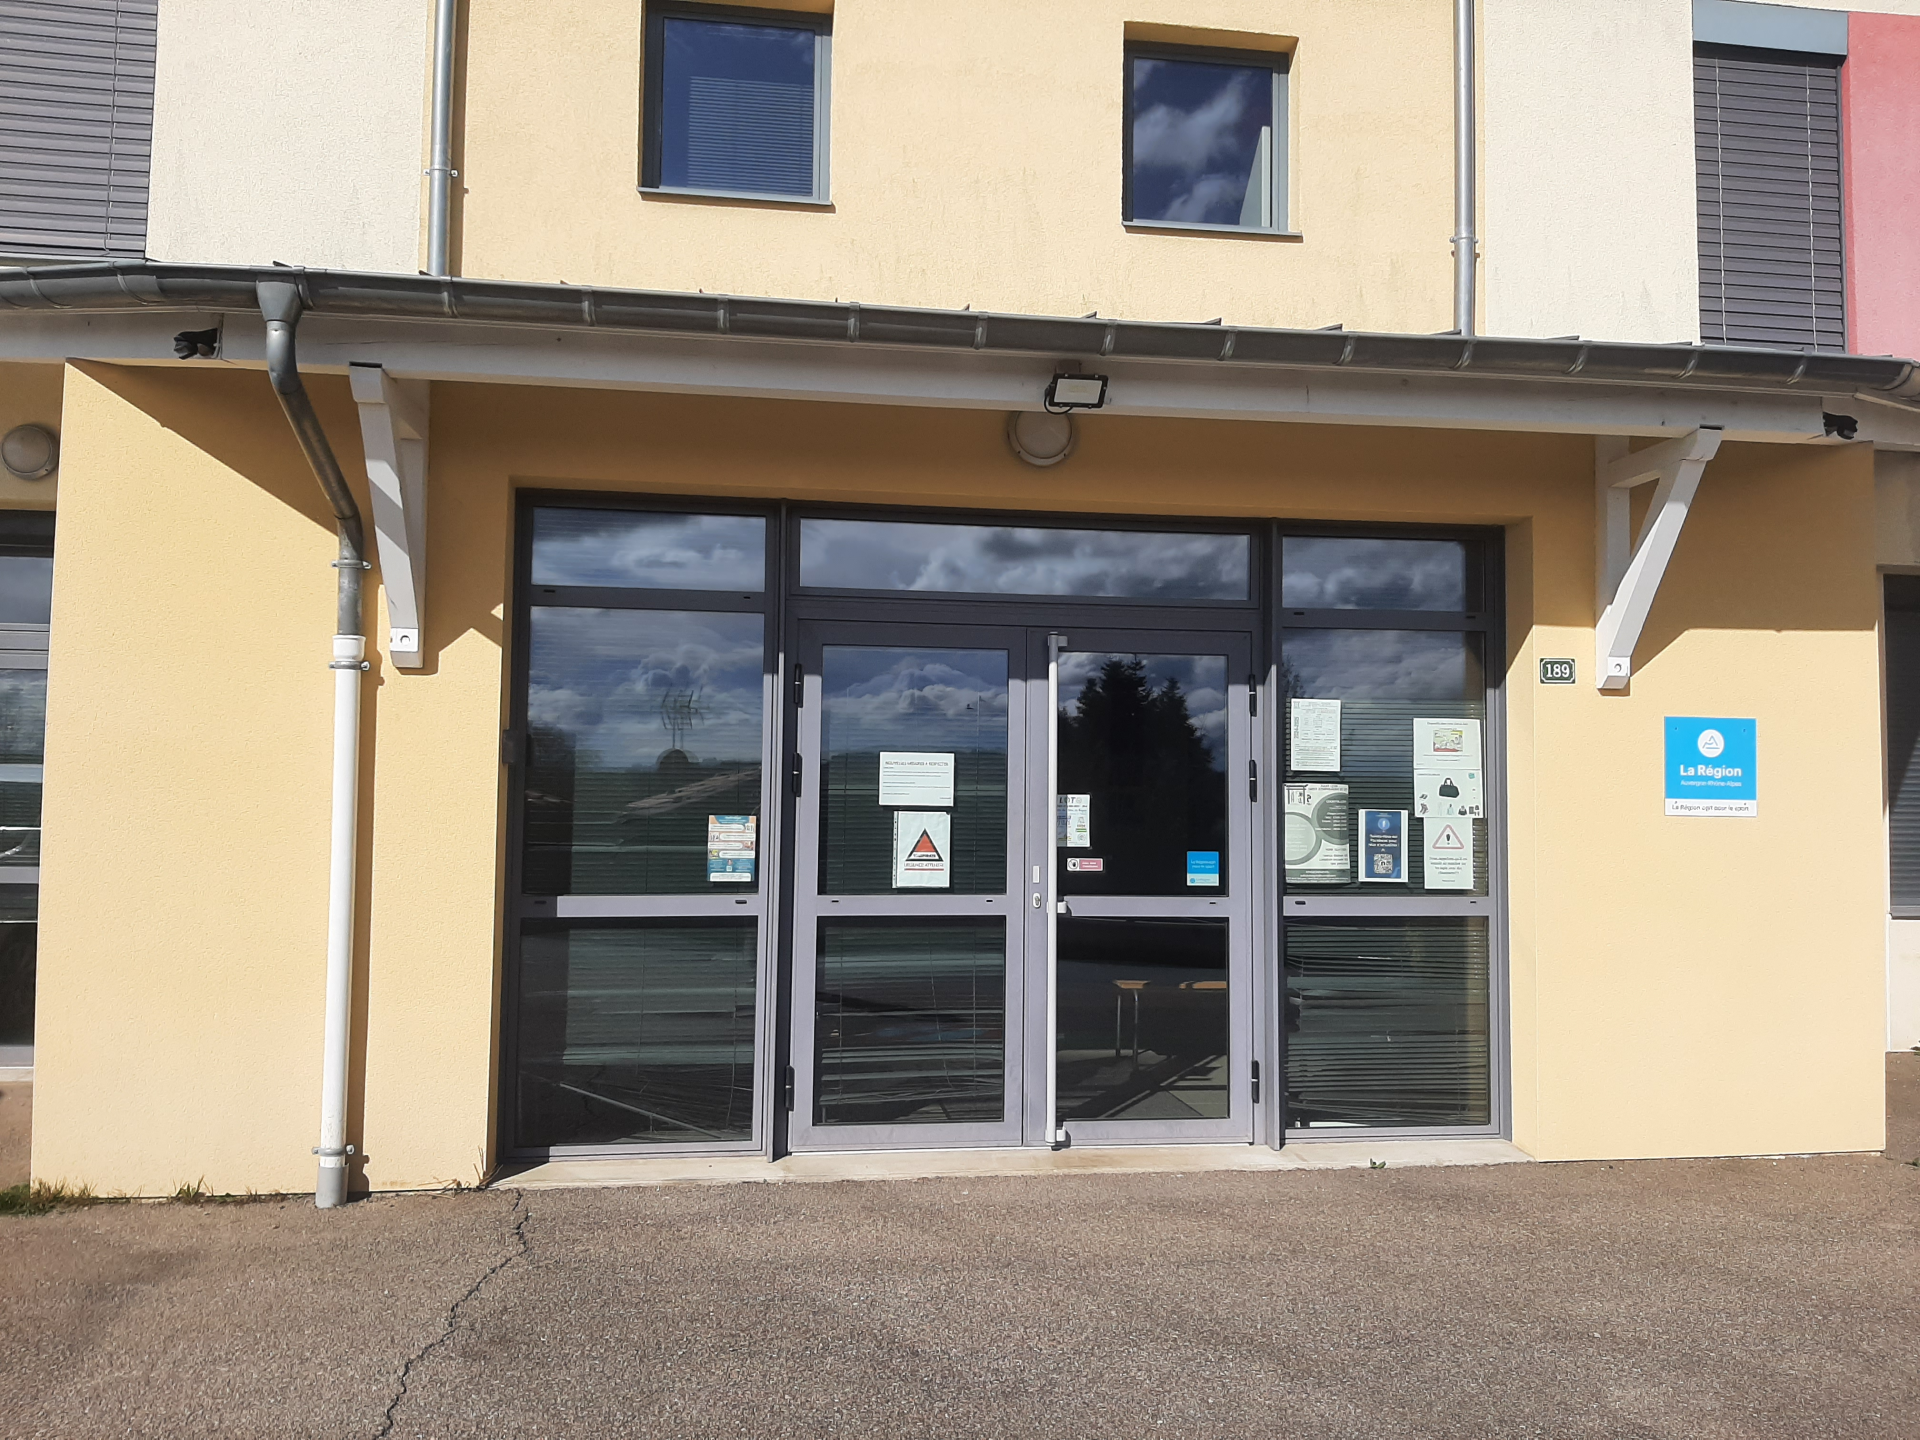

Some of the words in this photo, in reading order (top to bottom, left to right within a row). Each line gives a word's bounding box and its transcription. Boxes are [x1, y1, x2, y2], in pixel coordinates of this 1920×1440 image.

[1546, 664, 1570, 678] 189
[1680, 764, 1695, 776] La
[1697, 764, 1742, 779] Région
[1680, 804, 1701, 812] Région
